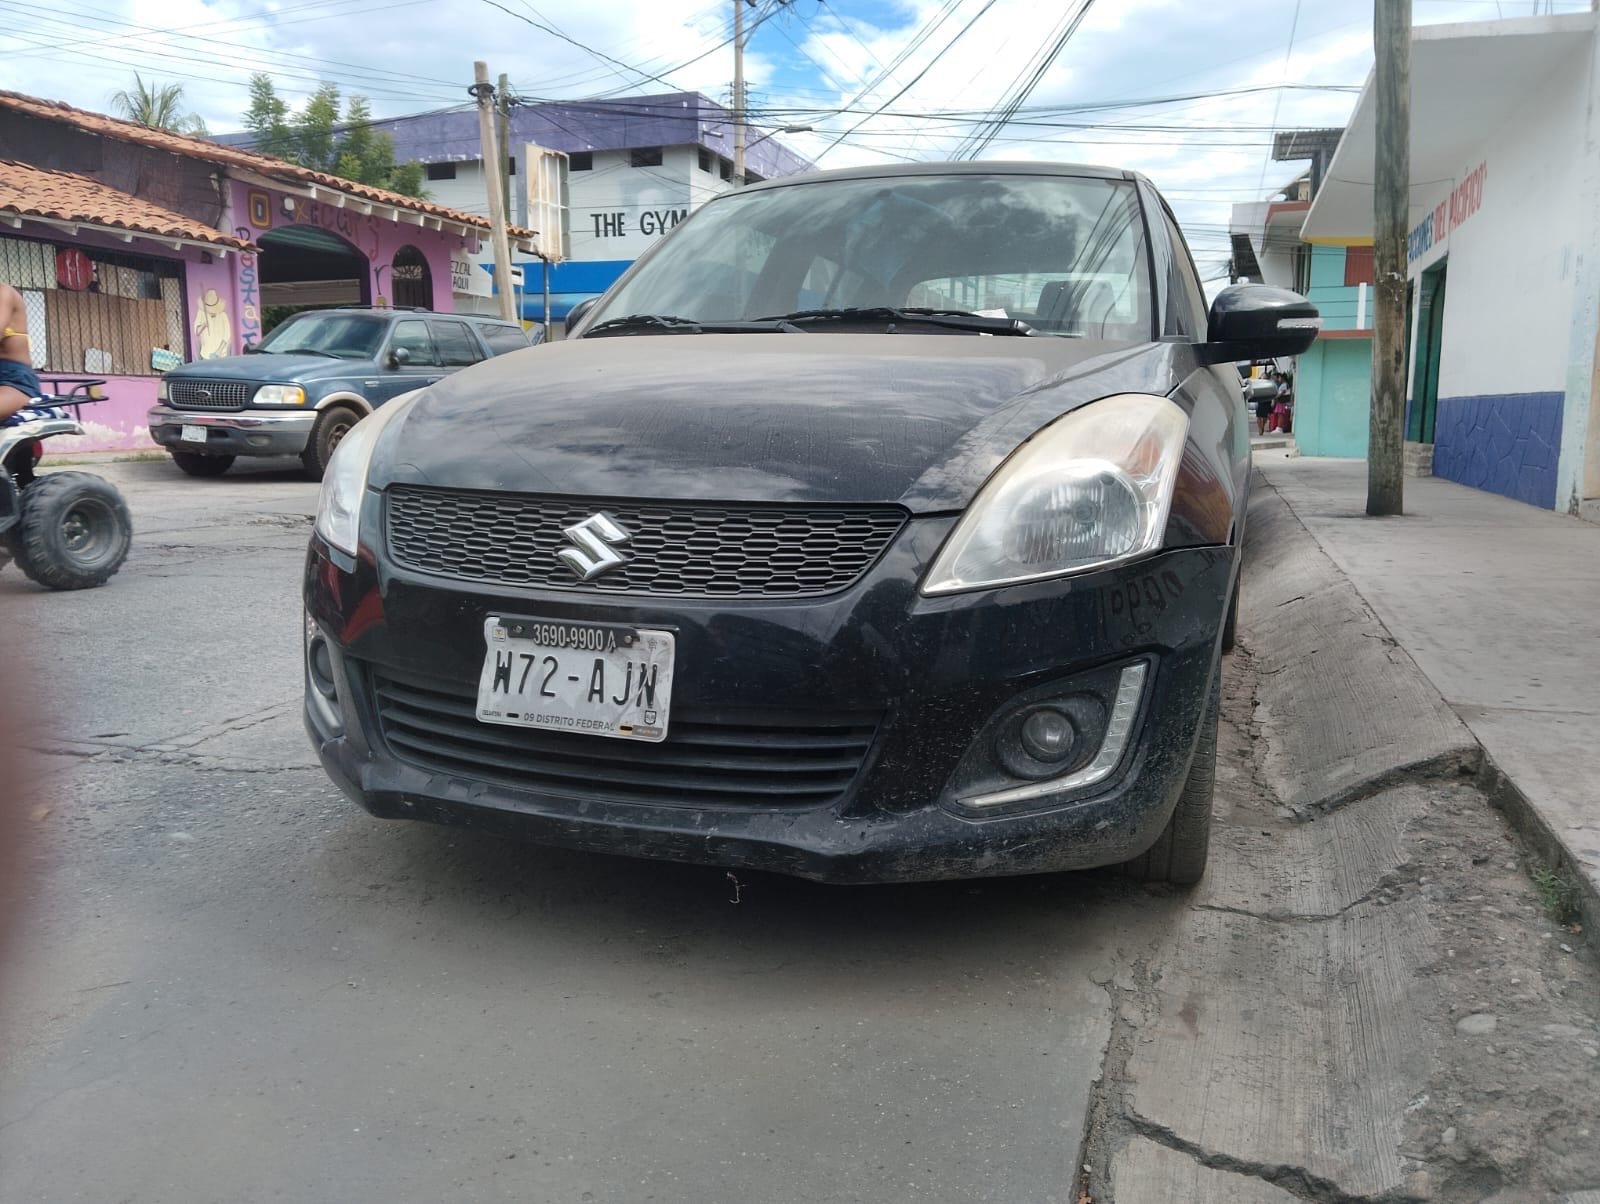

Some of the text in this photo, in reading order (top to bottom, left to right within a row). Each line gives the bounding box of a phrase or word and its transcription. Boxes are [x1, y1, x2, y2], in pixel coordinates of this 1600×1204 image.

[590, 209, 688, 238] THE GYM
[533, 623, 605, 651] 3690-9900
[493, 650, 659, 709] W72-AJN
[523, 712, 536, 722] 09
[535, 714, 576, 727] DISTRITO
